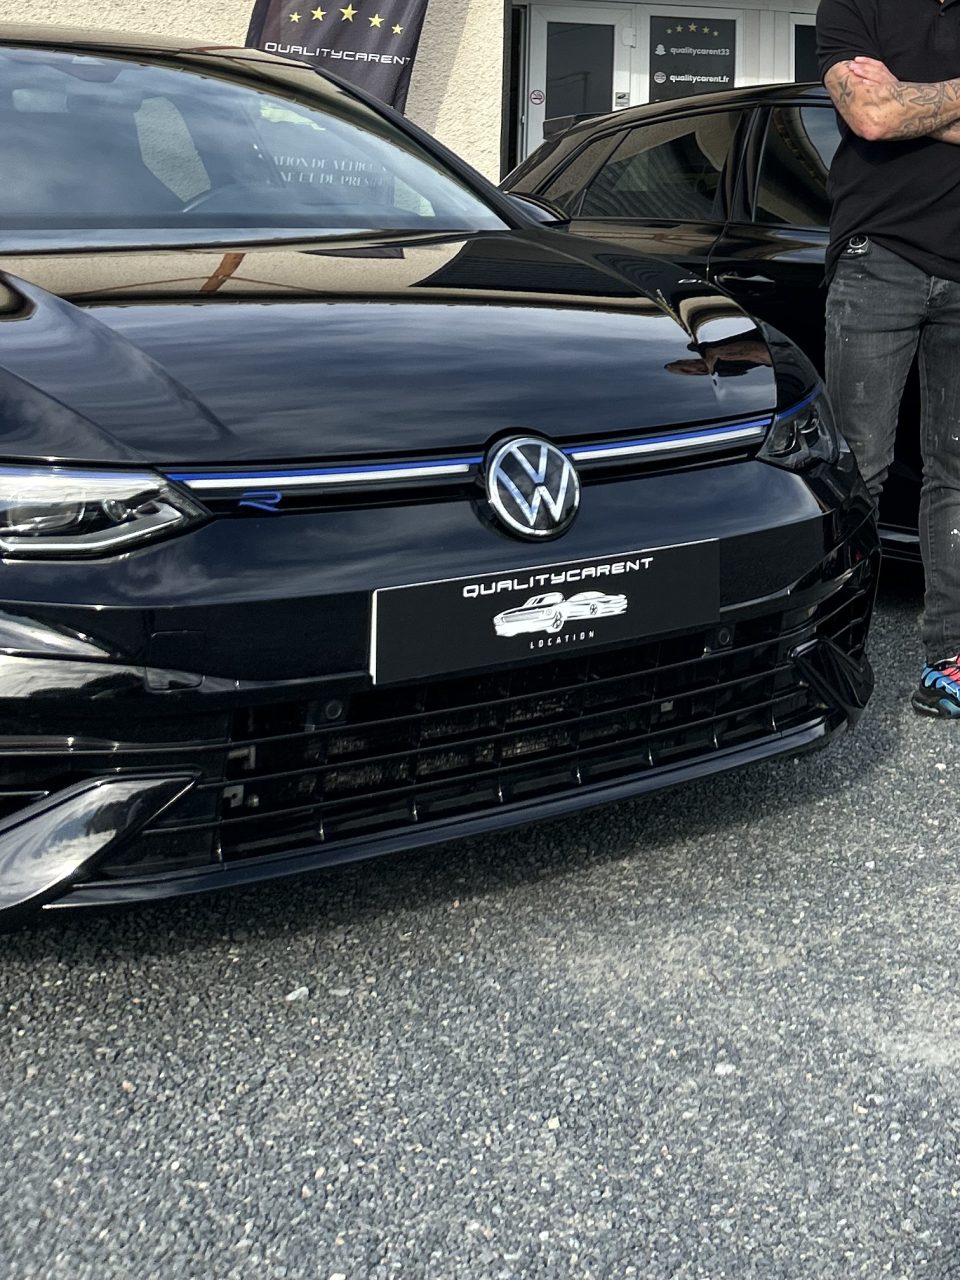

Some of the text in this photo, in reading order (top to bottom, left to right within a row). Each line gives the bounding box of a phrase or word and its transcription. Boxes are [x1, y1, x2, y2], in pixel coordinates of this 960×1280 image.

[264, 42, 411, 65] QUALITYCARENT
[670, 46, 730, 56] qualitycarent33
[669, 74, 730, 84] qualitycarent.fr
[463, 557, 654, 598] QUALITYCARENT
[530, 630, 596, 650] LOCATION
